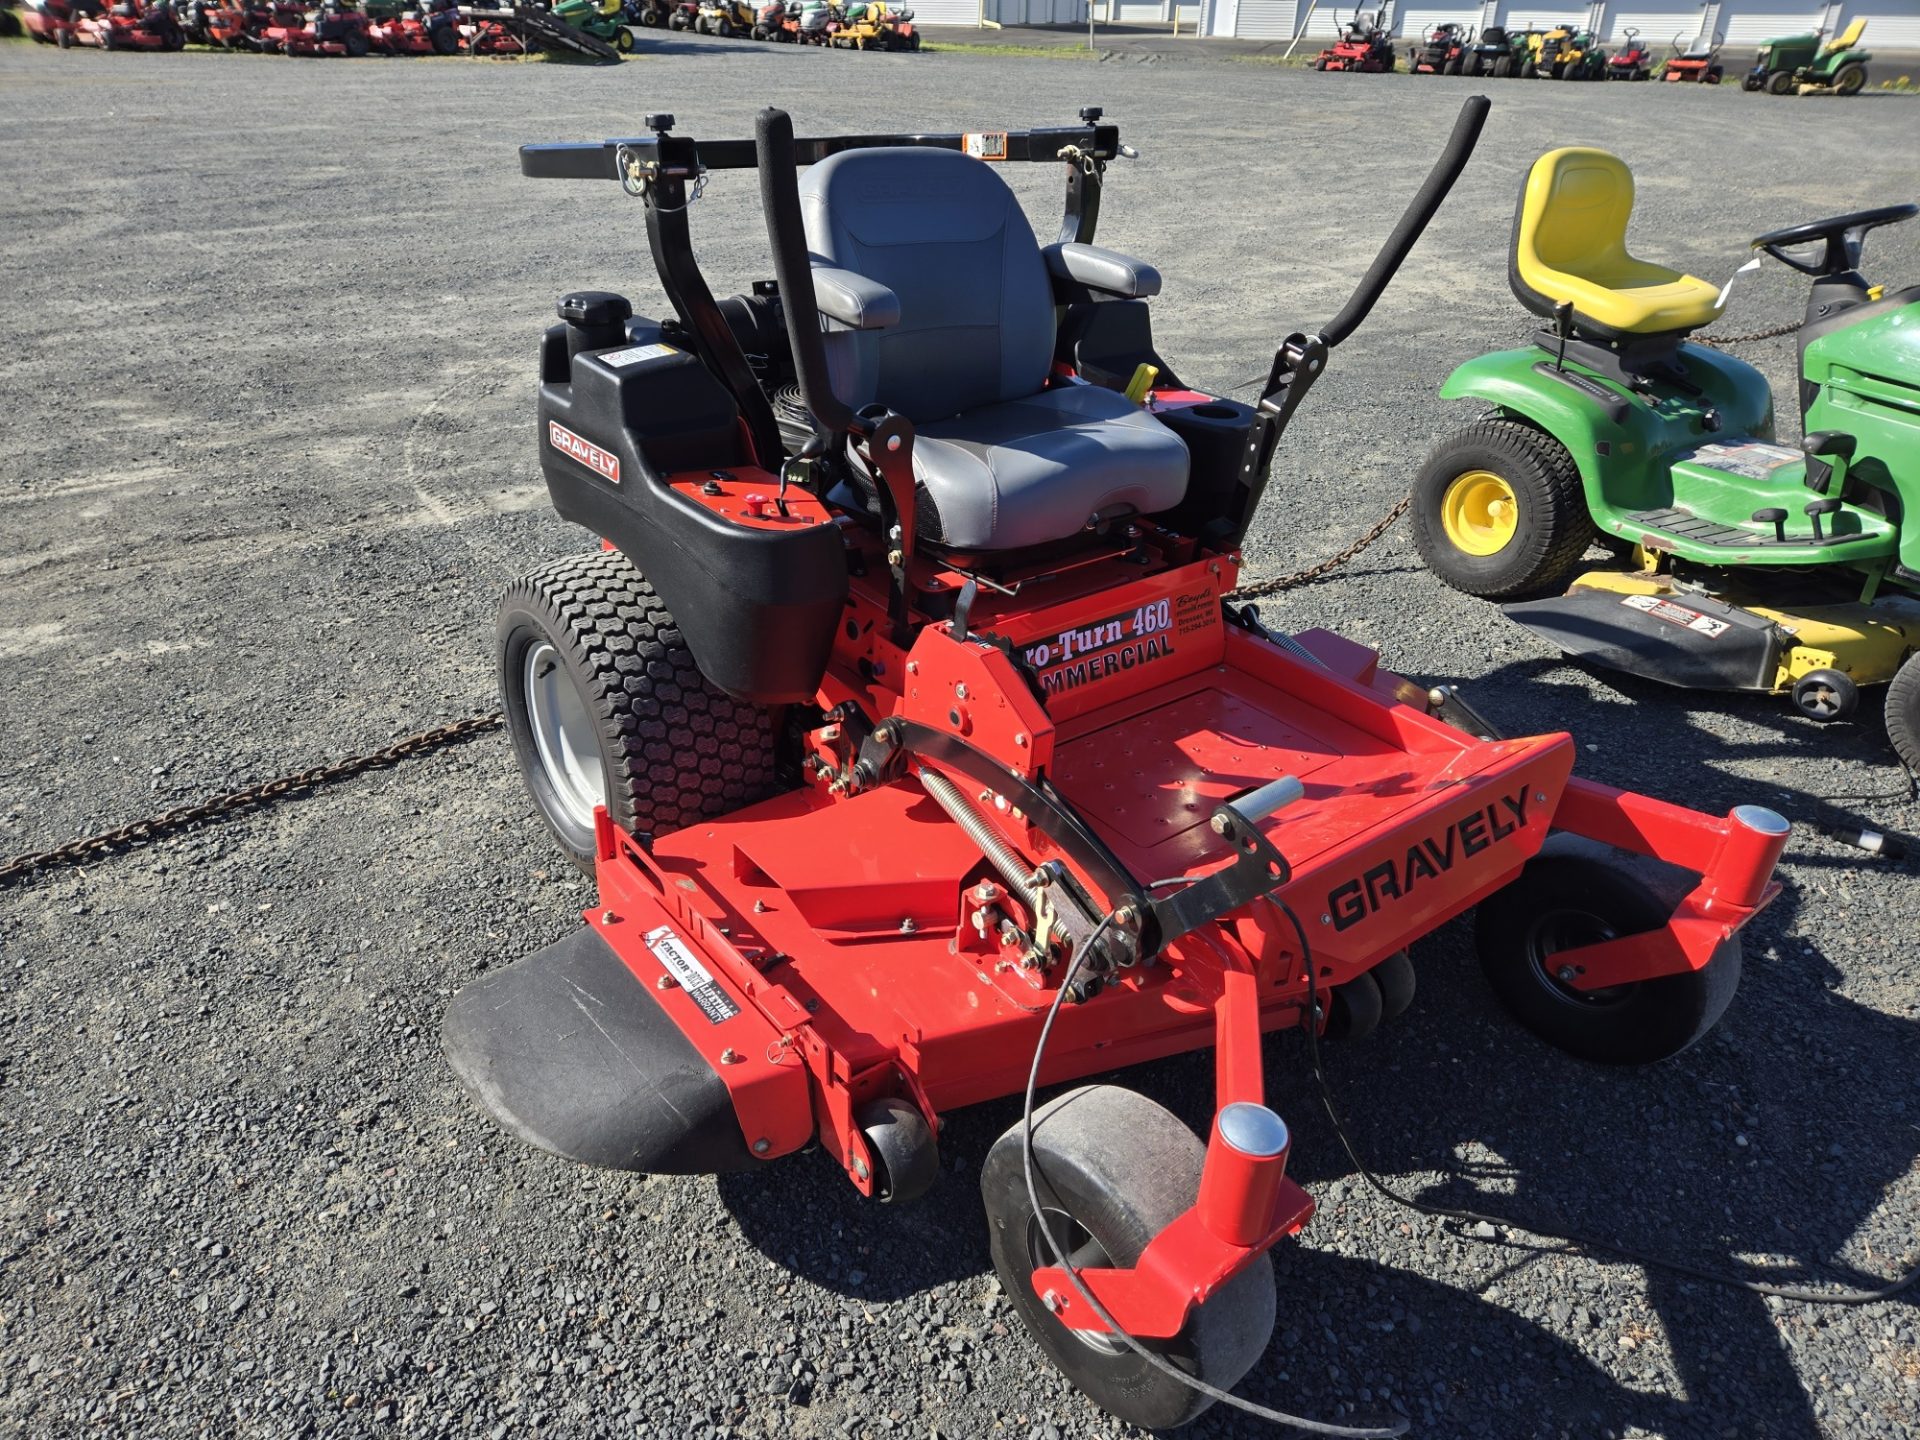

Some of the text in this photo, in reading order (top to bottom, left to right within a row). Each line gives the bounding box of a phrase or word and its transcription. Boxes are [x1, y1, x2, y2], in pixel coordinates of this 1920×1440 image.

[552, 427, 616, 476] GRAVELY
[1025, 620, 1123, 667] ro-Turn
[1132, 599, 1170, 636] 460
[1042, 635, 1174, 695] MMERCIAL
[1328, 784, 1530, 933] GRAVELY
[691, 988, 725, 1023] WARRANTY
[699, 984, 734, 1019] LIFETIME
